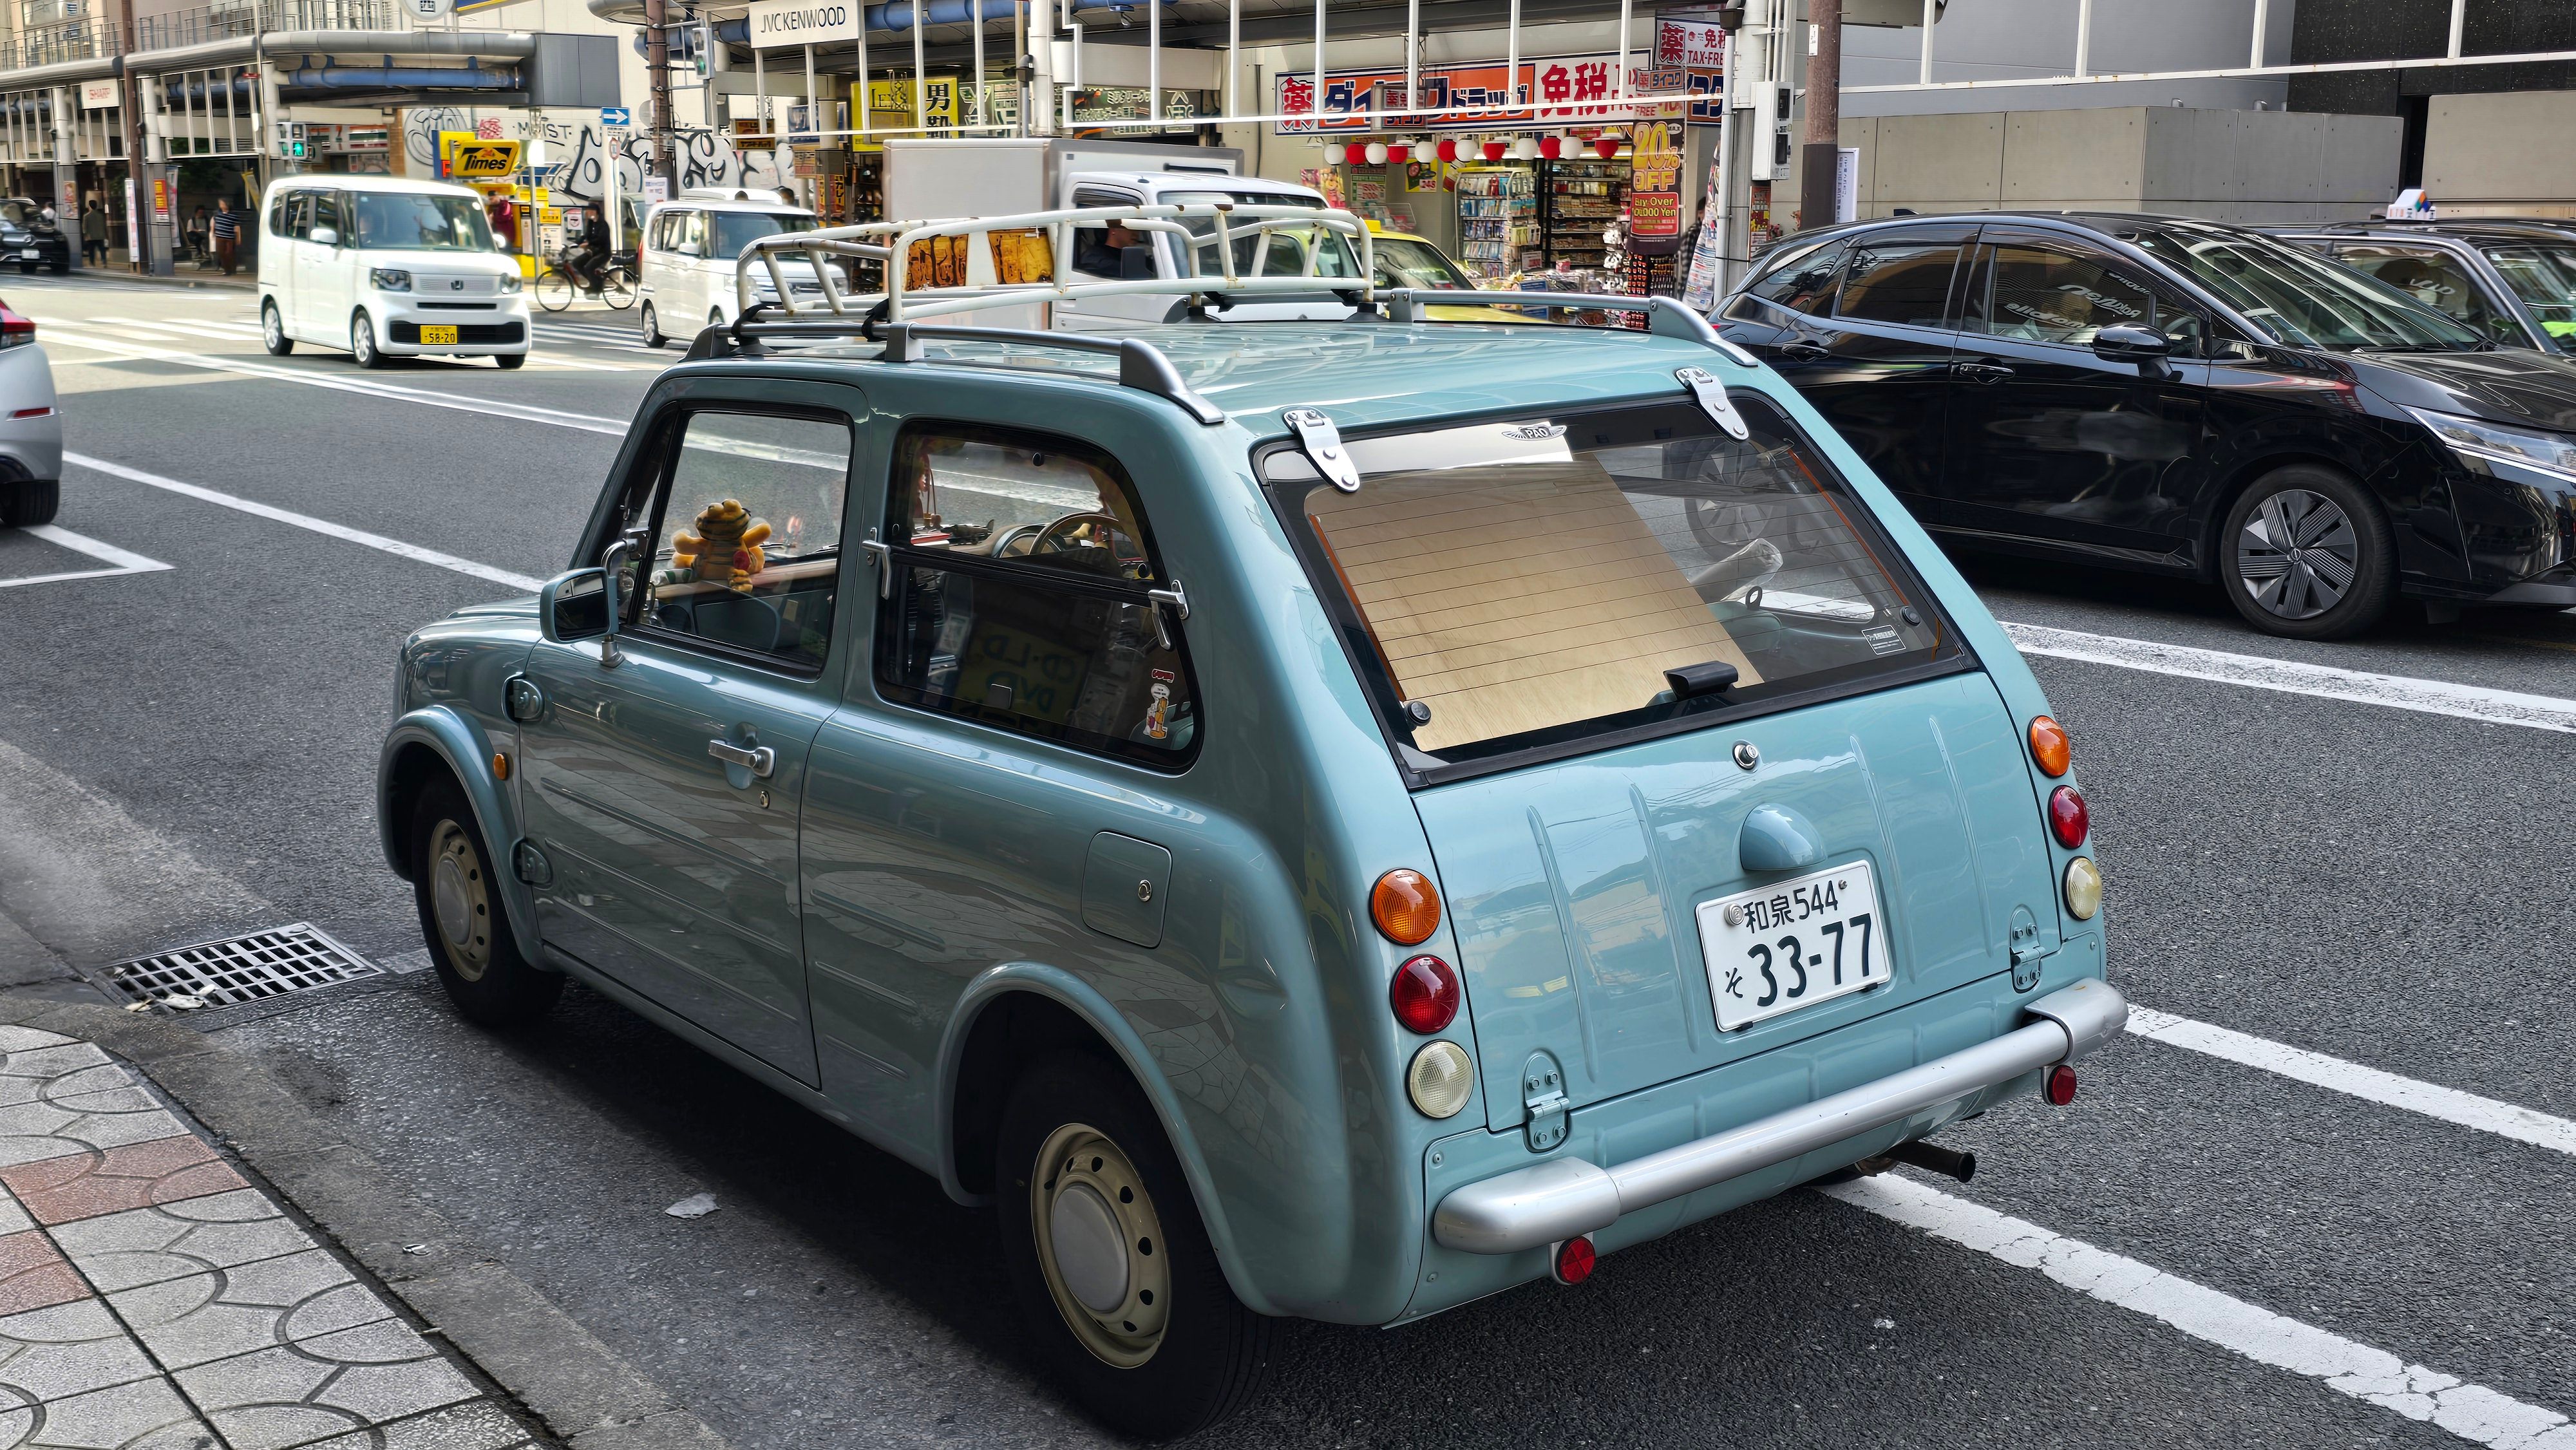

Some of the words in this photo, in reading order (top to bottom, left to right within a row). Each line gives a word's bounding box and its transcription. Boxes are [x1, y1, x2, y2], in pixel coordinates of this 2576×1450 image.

[760, 6, 846, 33] JVCKENWOOD
[1659, 22, 1686, 64] 薬
[1687, 50, 1724, 66] TAX-FRE
[1653, 71, 1681, 88] ダイコク
[1540, 62, 1608, 118] 免税
[1280, 76, 1315, 131] 薬
[463, 154, 507, 171] Times
[1633, 169, 1676, 192] OFF
[1649, 196, 1674, 206] Over
[1660, 207, 1676, 216] Yen
[1524, 428, 1549, 439] PAO
[1725, 967, 1744, 999] そ
[1747, 912, 1872, 1007] 33-77
